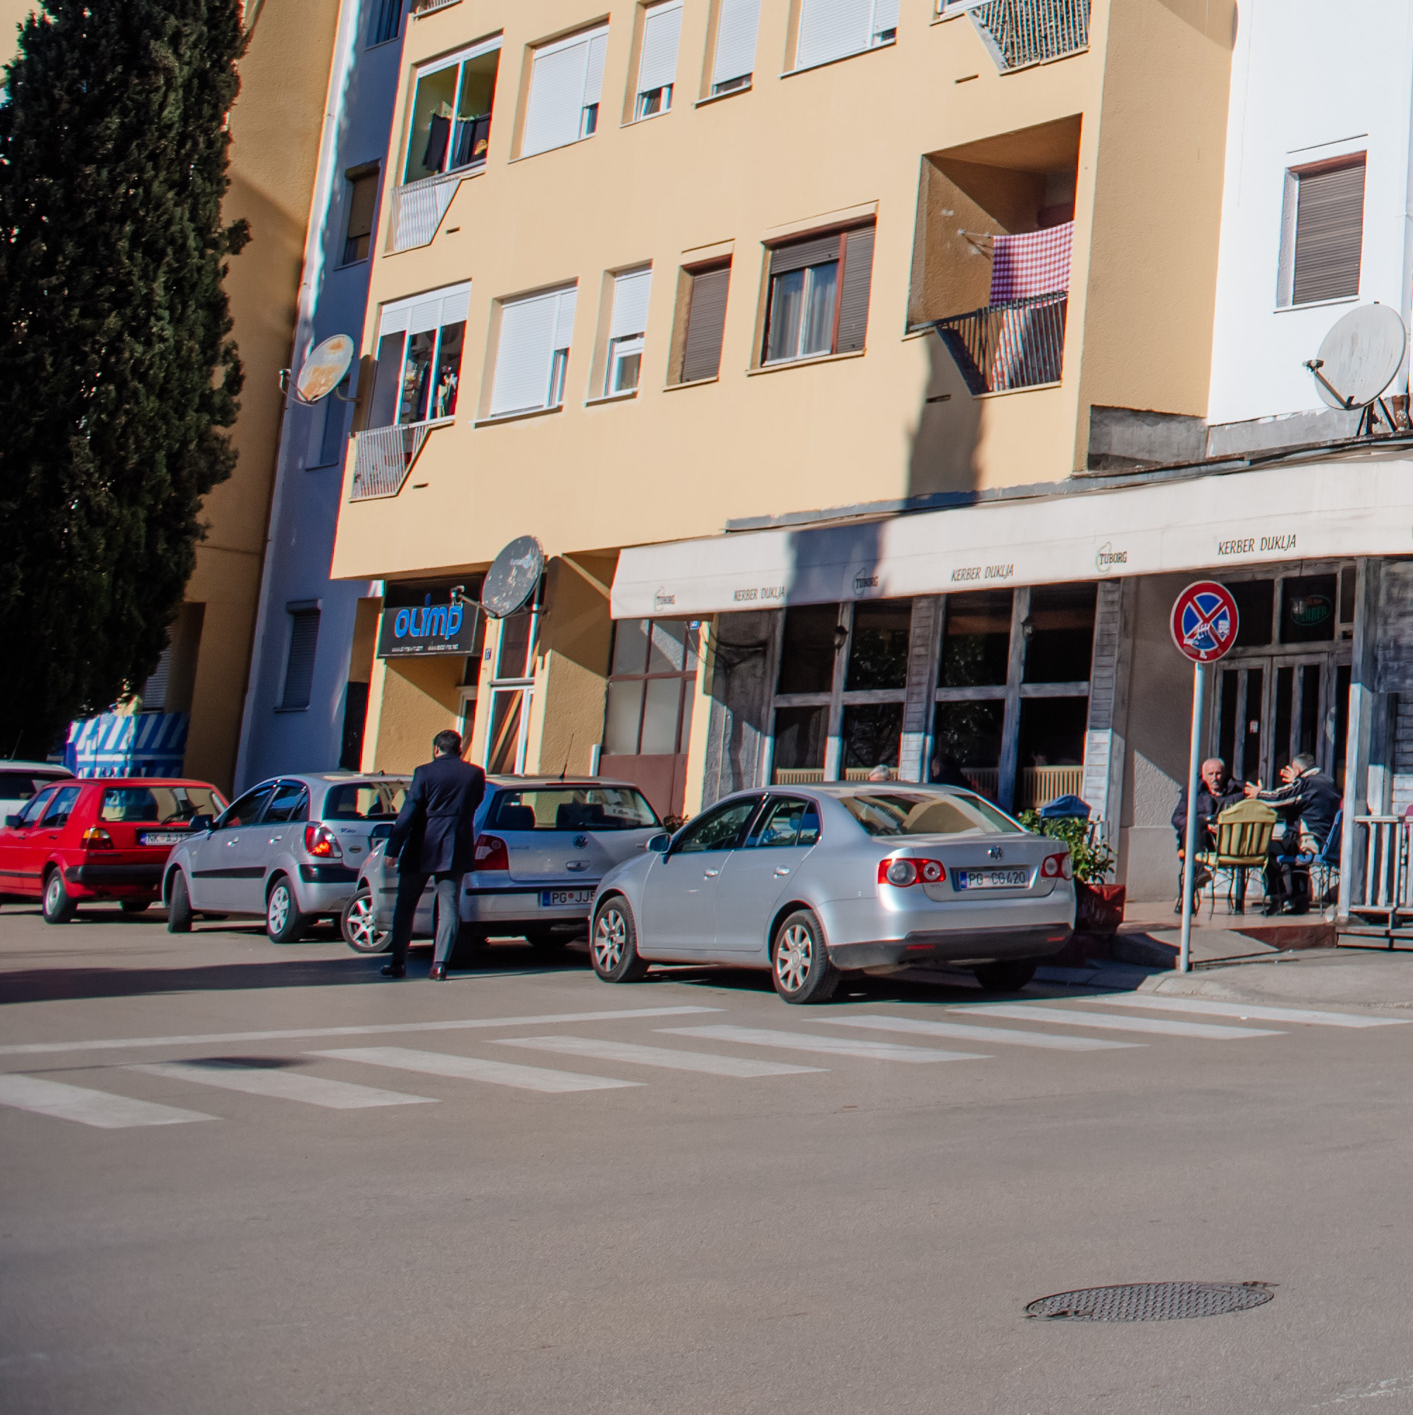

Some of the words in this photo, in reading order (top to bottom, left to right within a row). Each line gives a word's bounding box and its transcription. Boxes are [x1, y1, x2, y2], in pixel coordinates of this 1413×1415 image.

[1217, 537, 1255, 556] KERBER
[1259, 533, 1297, 552] DUKLJA
[1099, 550, 1128, 565] TUBORG
[950, 566, 981, 582] KERBER
[984, 563, 1014, 580] DUKLJA
[855, 576, 879, 589] TUBORG
[656, 594, 676, 605] TUBORG
[733, 588, 758, 602] KERBER
[760, 586, 786, 601] DUKLJA
[968, 872, 983, 886] PG
[991, 871, 1026, 885] CG420
[551, 892, 567, 903] PG
